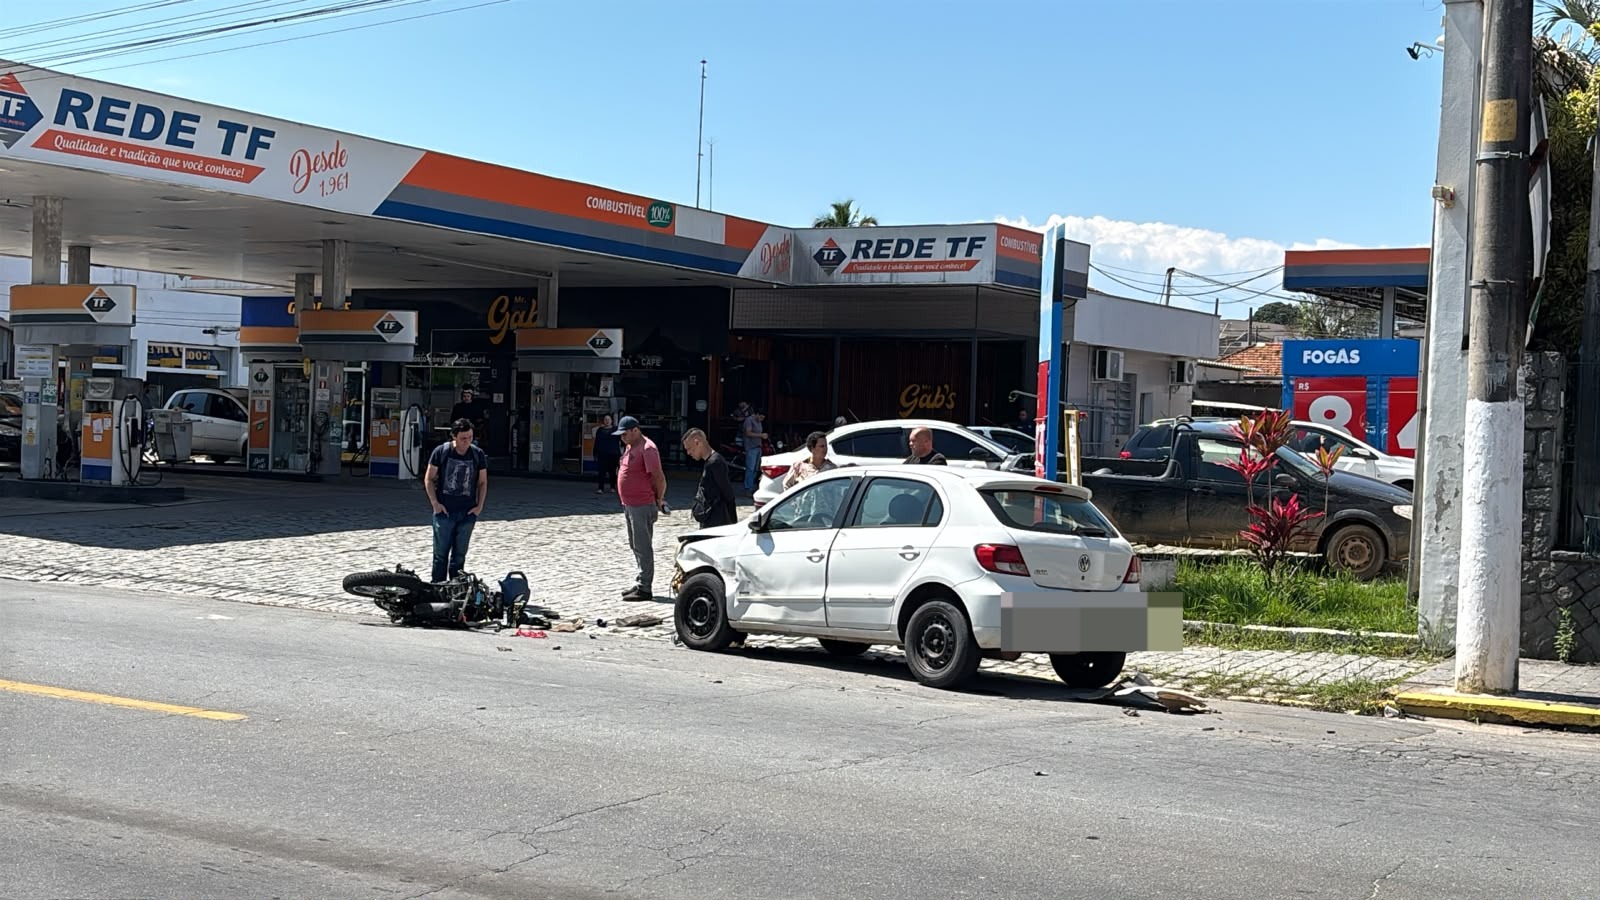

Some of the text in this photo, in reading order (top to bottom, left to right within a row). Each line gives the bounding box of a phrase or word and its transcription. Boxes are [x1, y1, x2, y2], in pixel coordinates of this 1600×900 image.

[53, 88, 276, 161] REDE TF
[54, 134, 245, 179] Qualidade e tradição que você conhece!
[290, 139, 348, 194] Desde
[320, 172, 348, 197] 1.961
[586, 196, 670, 221] COMBUSTÍVEL 100%
[822, 249, 838, 260] TF
[851, 236, 987, 260] REDE TF
[92, 298, 108, 308] TF
[383, 321, 396, 330] TF
[488, 294, 538, 345] Gab
[898, 383, 957, 418] Gab's
